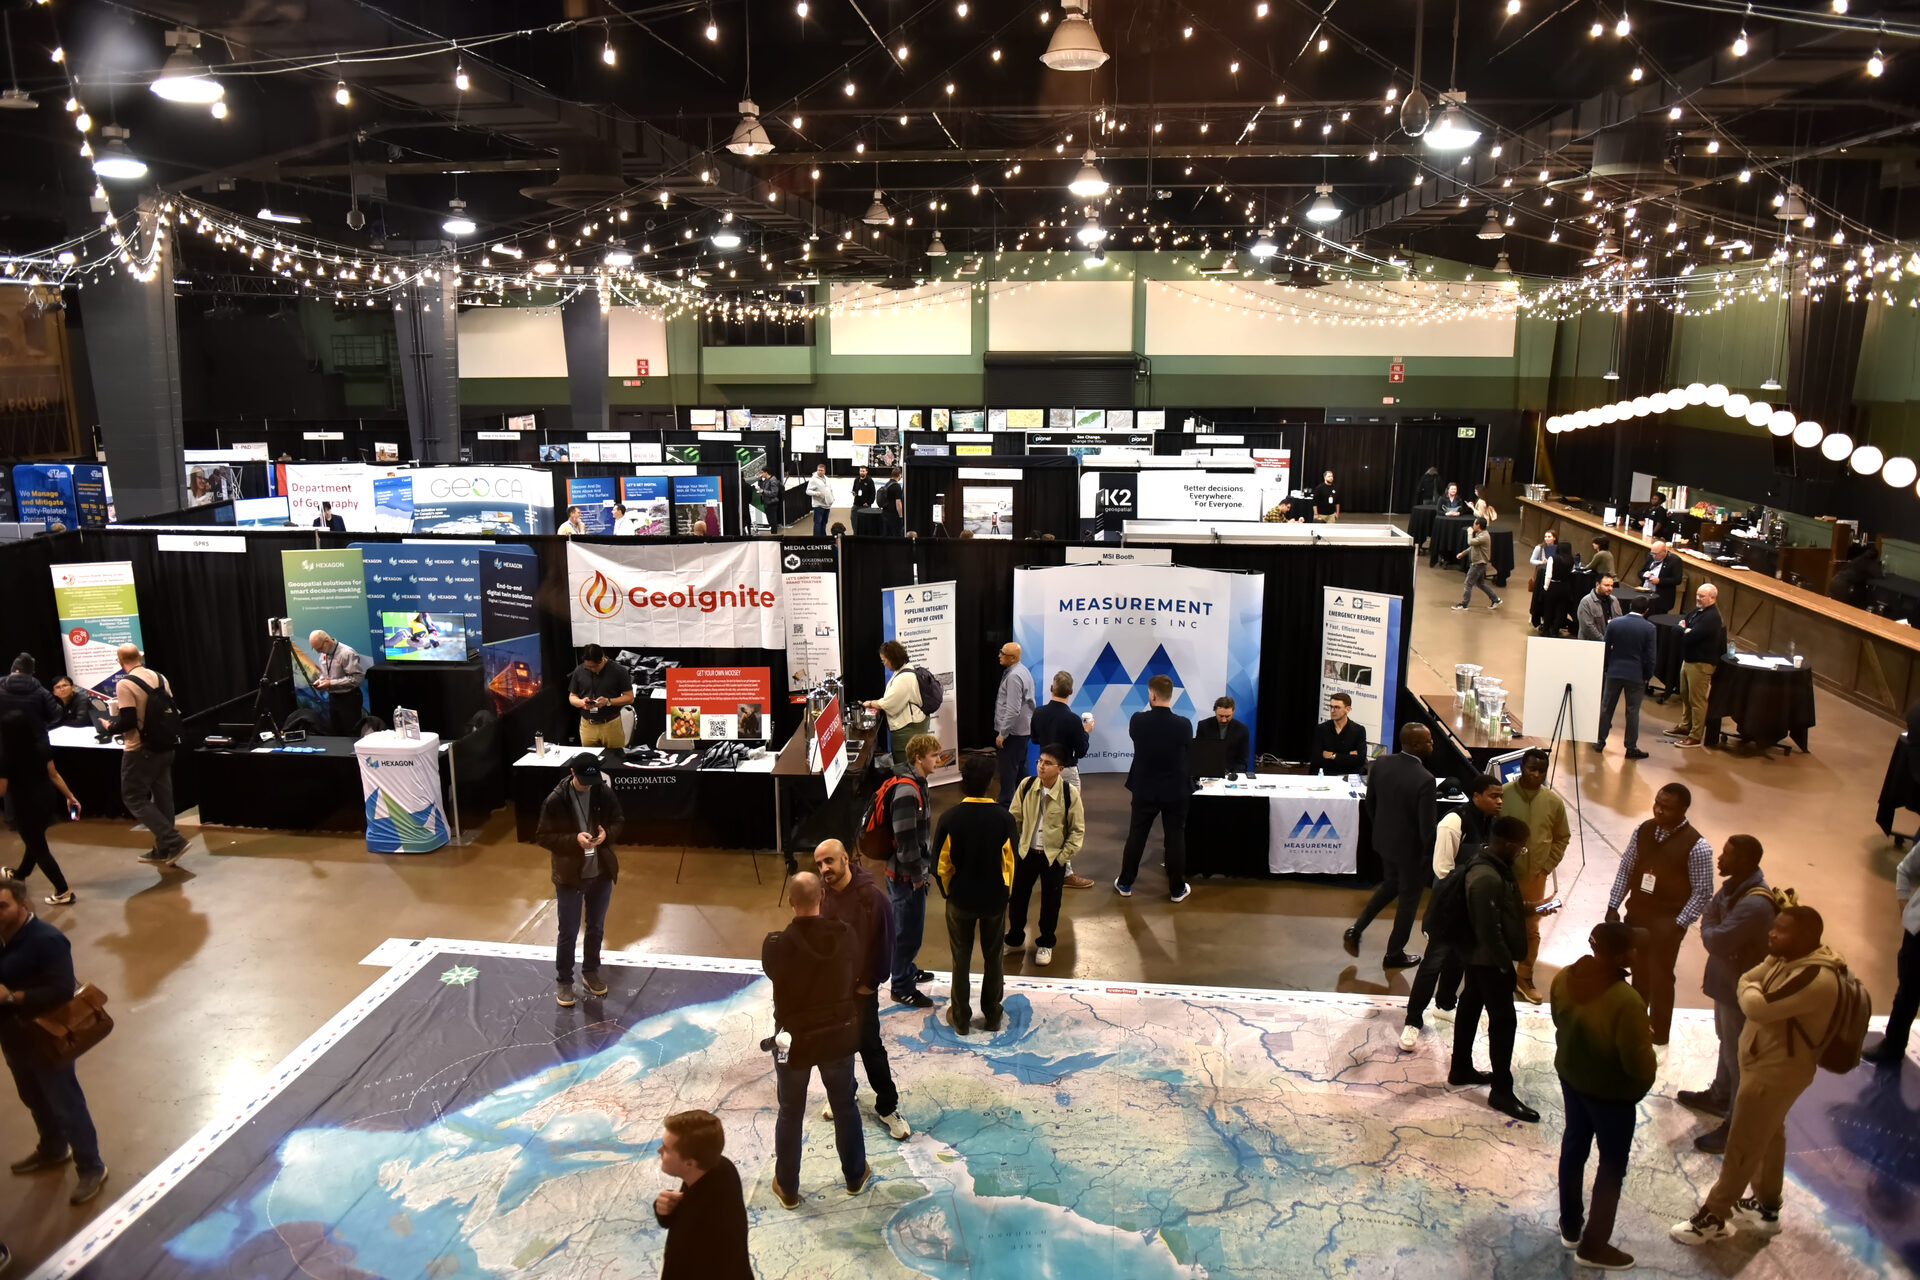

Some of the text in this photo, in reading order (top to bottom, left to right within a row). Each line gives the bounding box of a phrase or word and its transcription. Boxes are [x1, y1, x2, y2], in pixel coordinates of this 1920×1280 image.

[291, 483, 352, 493] Department
[1105, 489, 1132, 506] K2
[292, 499, 358, 510] of Geraphy
[497, 583, 522, 591] End-to-end
[628, 584, 776, 613] GeoIgnite
[1060, 597, 1213, 616] MEASUREMENT
[1072, 617, 1197, 628] SCIENCES INC
[1328, 610, 1380, 623] EMERGENCY RESPONSE
[982, 1108, 1092, 1118] ONTARIO
[1342, 1215, 1436, 1230] SASKATCHEWAN
